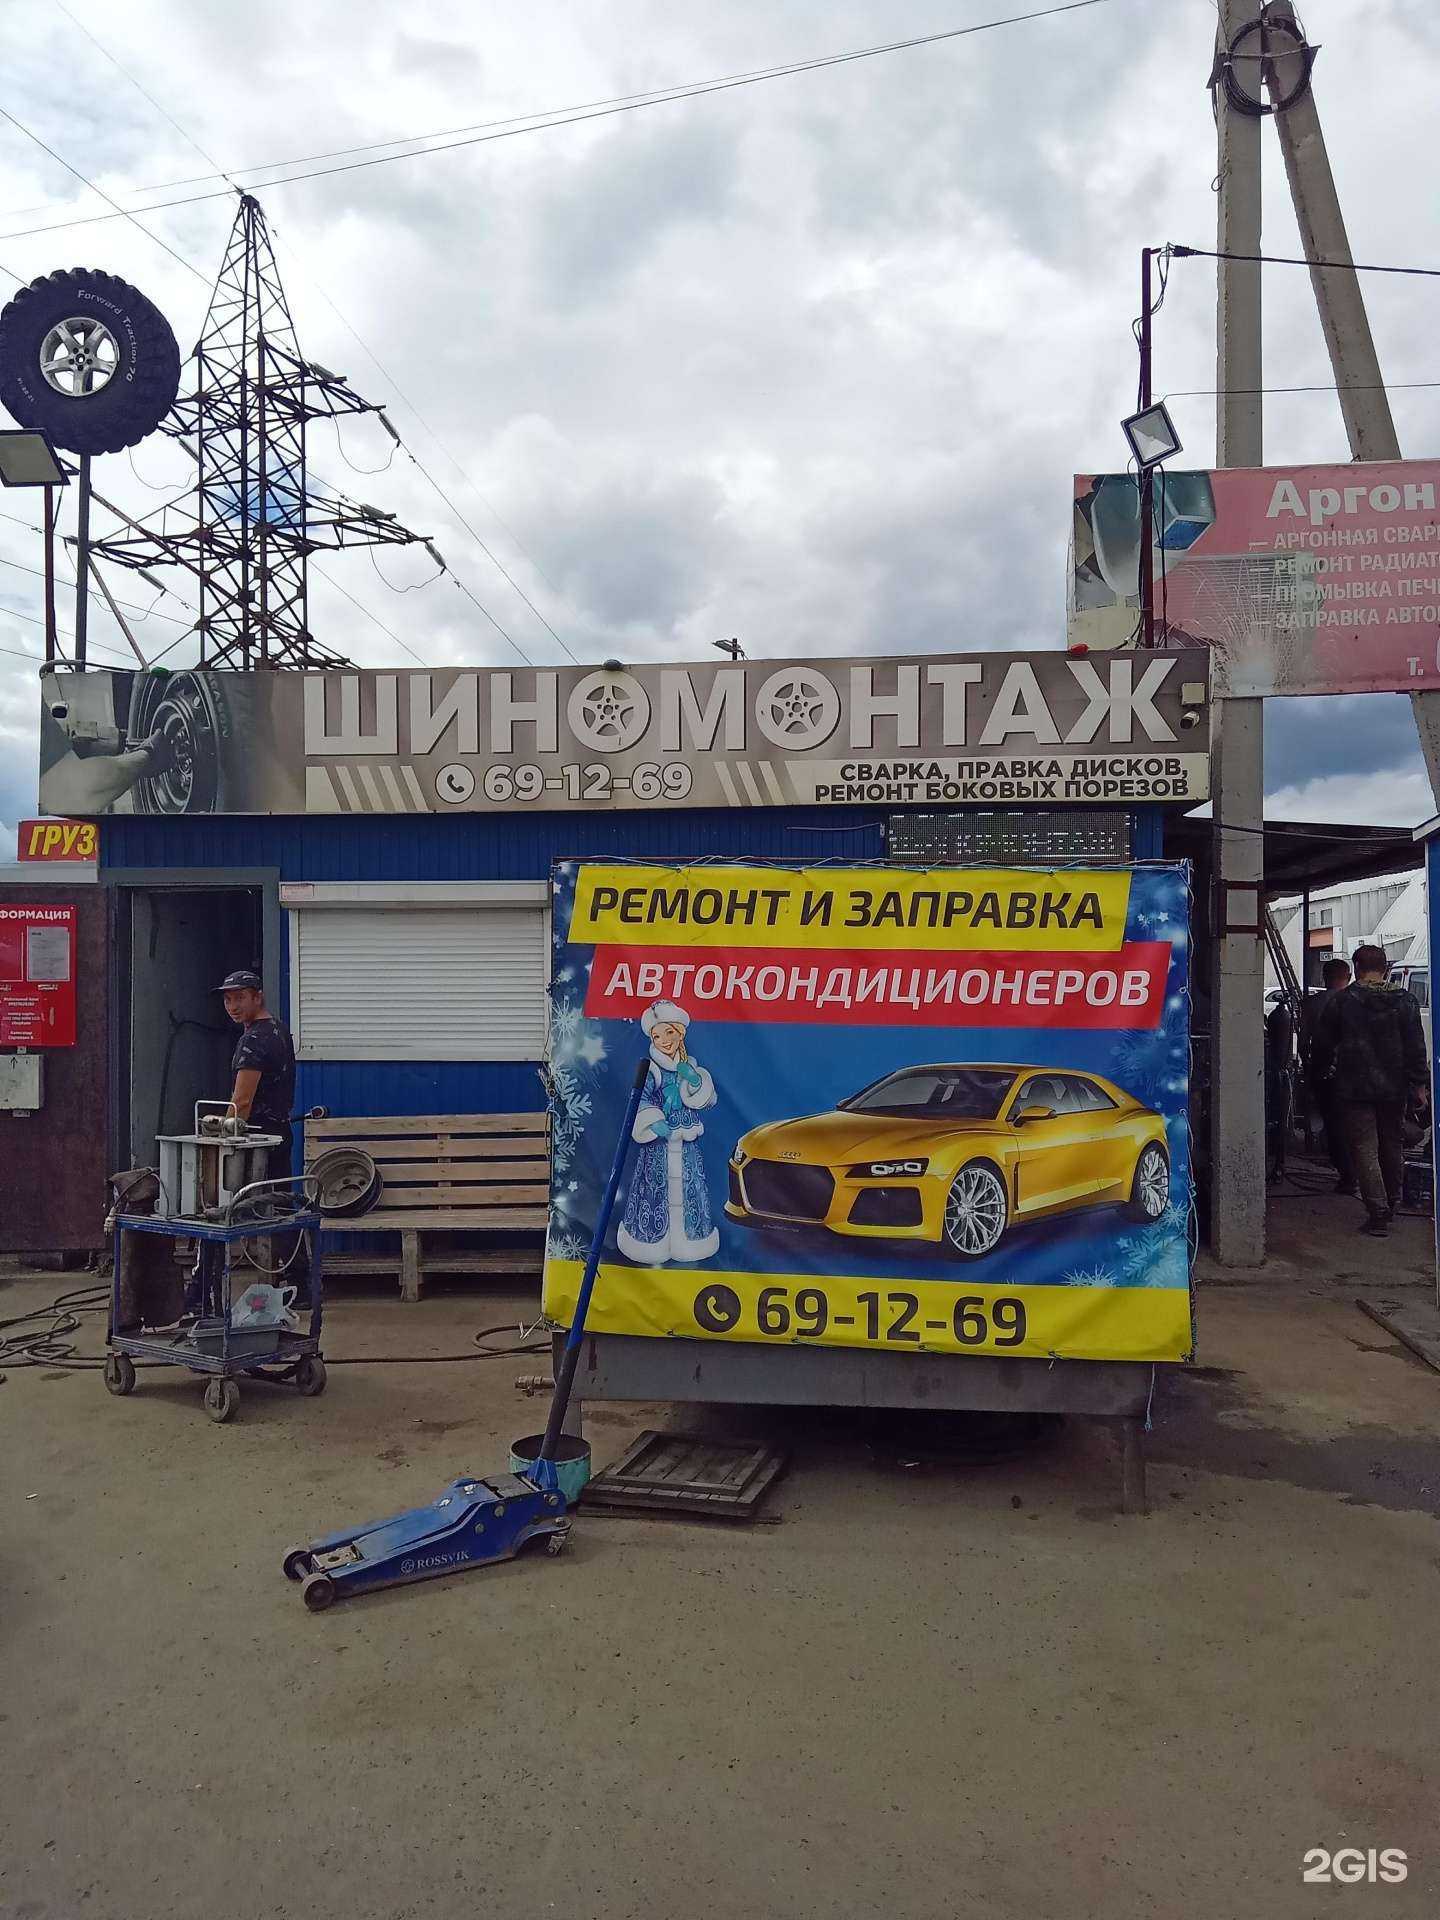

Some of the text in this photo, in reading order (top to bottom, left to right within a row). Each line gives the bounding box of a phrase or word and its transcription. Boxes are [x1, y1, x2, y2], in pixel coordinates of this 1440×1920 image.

[78, 289, 123, 315] Forward
[123, 316, 137, 363] Traction
[1266, 480, 1435, 525] Аргон
[1274, 525, 1440, 549] АРГОННАЯ СВАР
[1275, 552, 1440, 576] РЕМОНТ РАДИАТ
[1398, 578, 1440, 597] ПЕЧ
[1275, 605, 1440, 628] ЗАПРАВКА АВТО
[304, 658, 1178, 755] ШИНОМОНТАЖ
[484, 762, 693, 801] 69-12-69
[840, 758, 1188, 783] СВАРКА, ПРАВКА ДИСКОВ,
[815, 778, 1188, 801] РЕМОНТ БОКОВЫХ ПОРЕЗОВ
[28, 824, 97, 856] ГРУЗ
[589, 887, 1105, 929] РЕМОНТ И ЗАПРАВКА
[603, 962, 1152, 1009] АВТОКОНДИЦИОНЕРОВ
[756, 1287, 1028, 1346] 69-12-69
